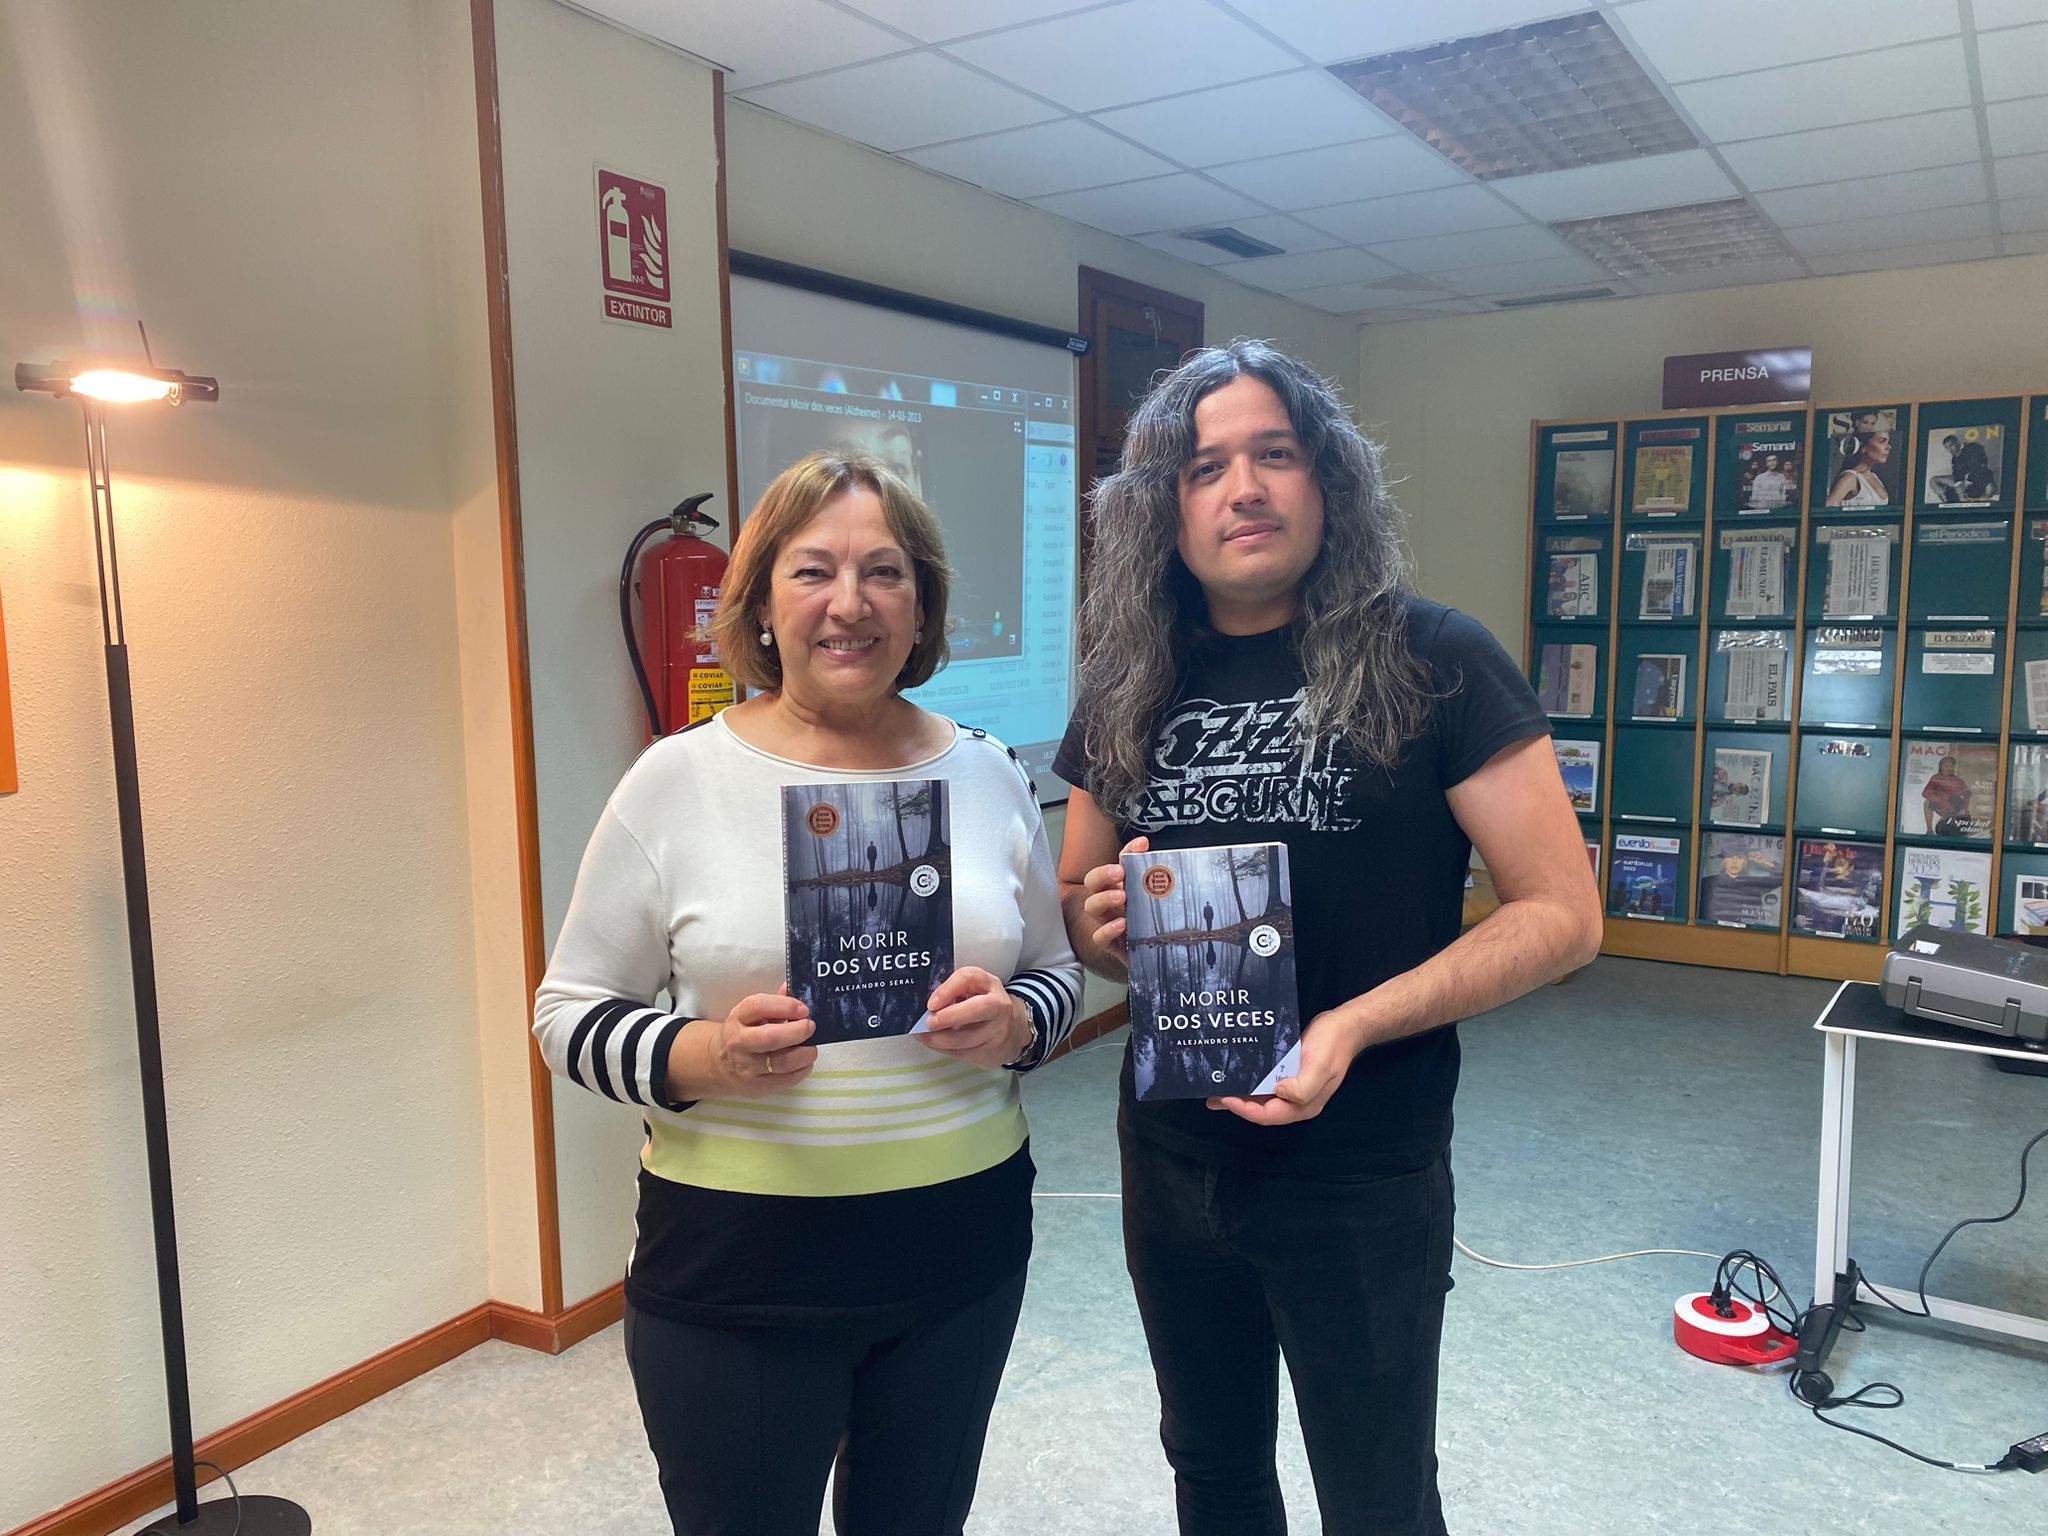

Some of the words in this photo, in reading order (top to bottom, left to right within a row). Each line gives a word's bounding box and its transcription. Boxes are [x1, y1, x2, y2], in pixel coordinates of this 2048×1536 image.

[610, 300, 666, 324] EXTINTOR
[1700, 366, 1769, 383] PRENSA
[744, 392, 790, 408] Documental
[1579, 573, 1590, 601] ABC
[1871, 556, 1881, 601] HERALDO
[1934, 635, 1943, 643] EL
[1945, 634, 1985, 643] CRUZADO
[1768, 663, 1778, 679] EL
[839, 931, 908, 952] MORIR
[817, 958, 859, 978] DOS
[866, 951, 931, 973] VECES
[834, 980, 885, 992] ALEJANDRO
[889, 977, 915, 987] SERAL
[1179, 989, 1250, 1007] MORIR
[1158, 1014, 1202, 1031] DOS
[1207, 1010, 1275, 1028] VECES
[1176, 1037, 1228, 1046] ALEJANDRO
[1232, 1036, 1259, 1045] SERAL
